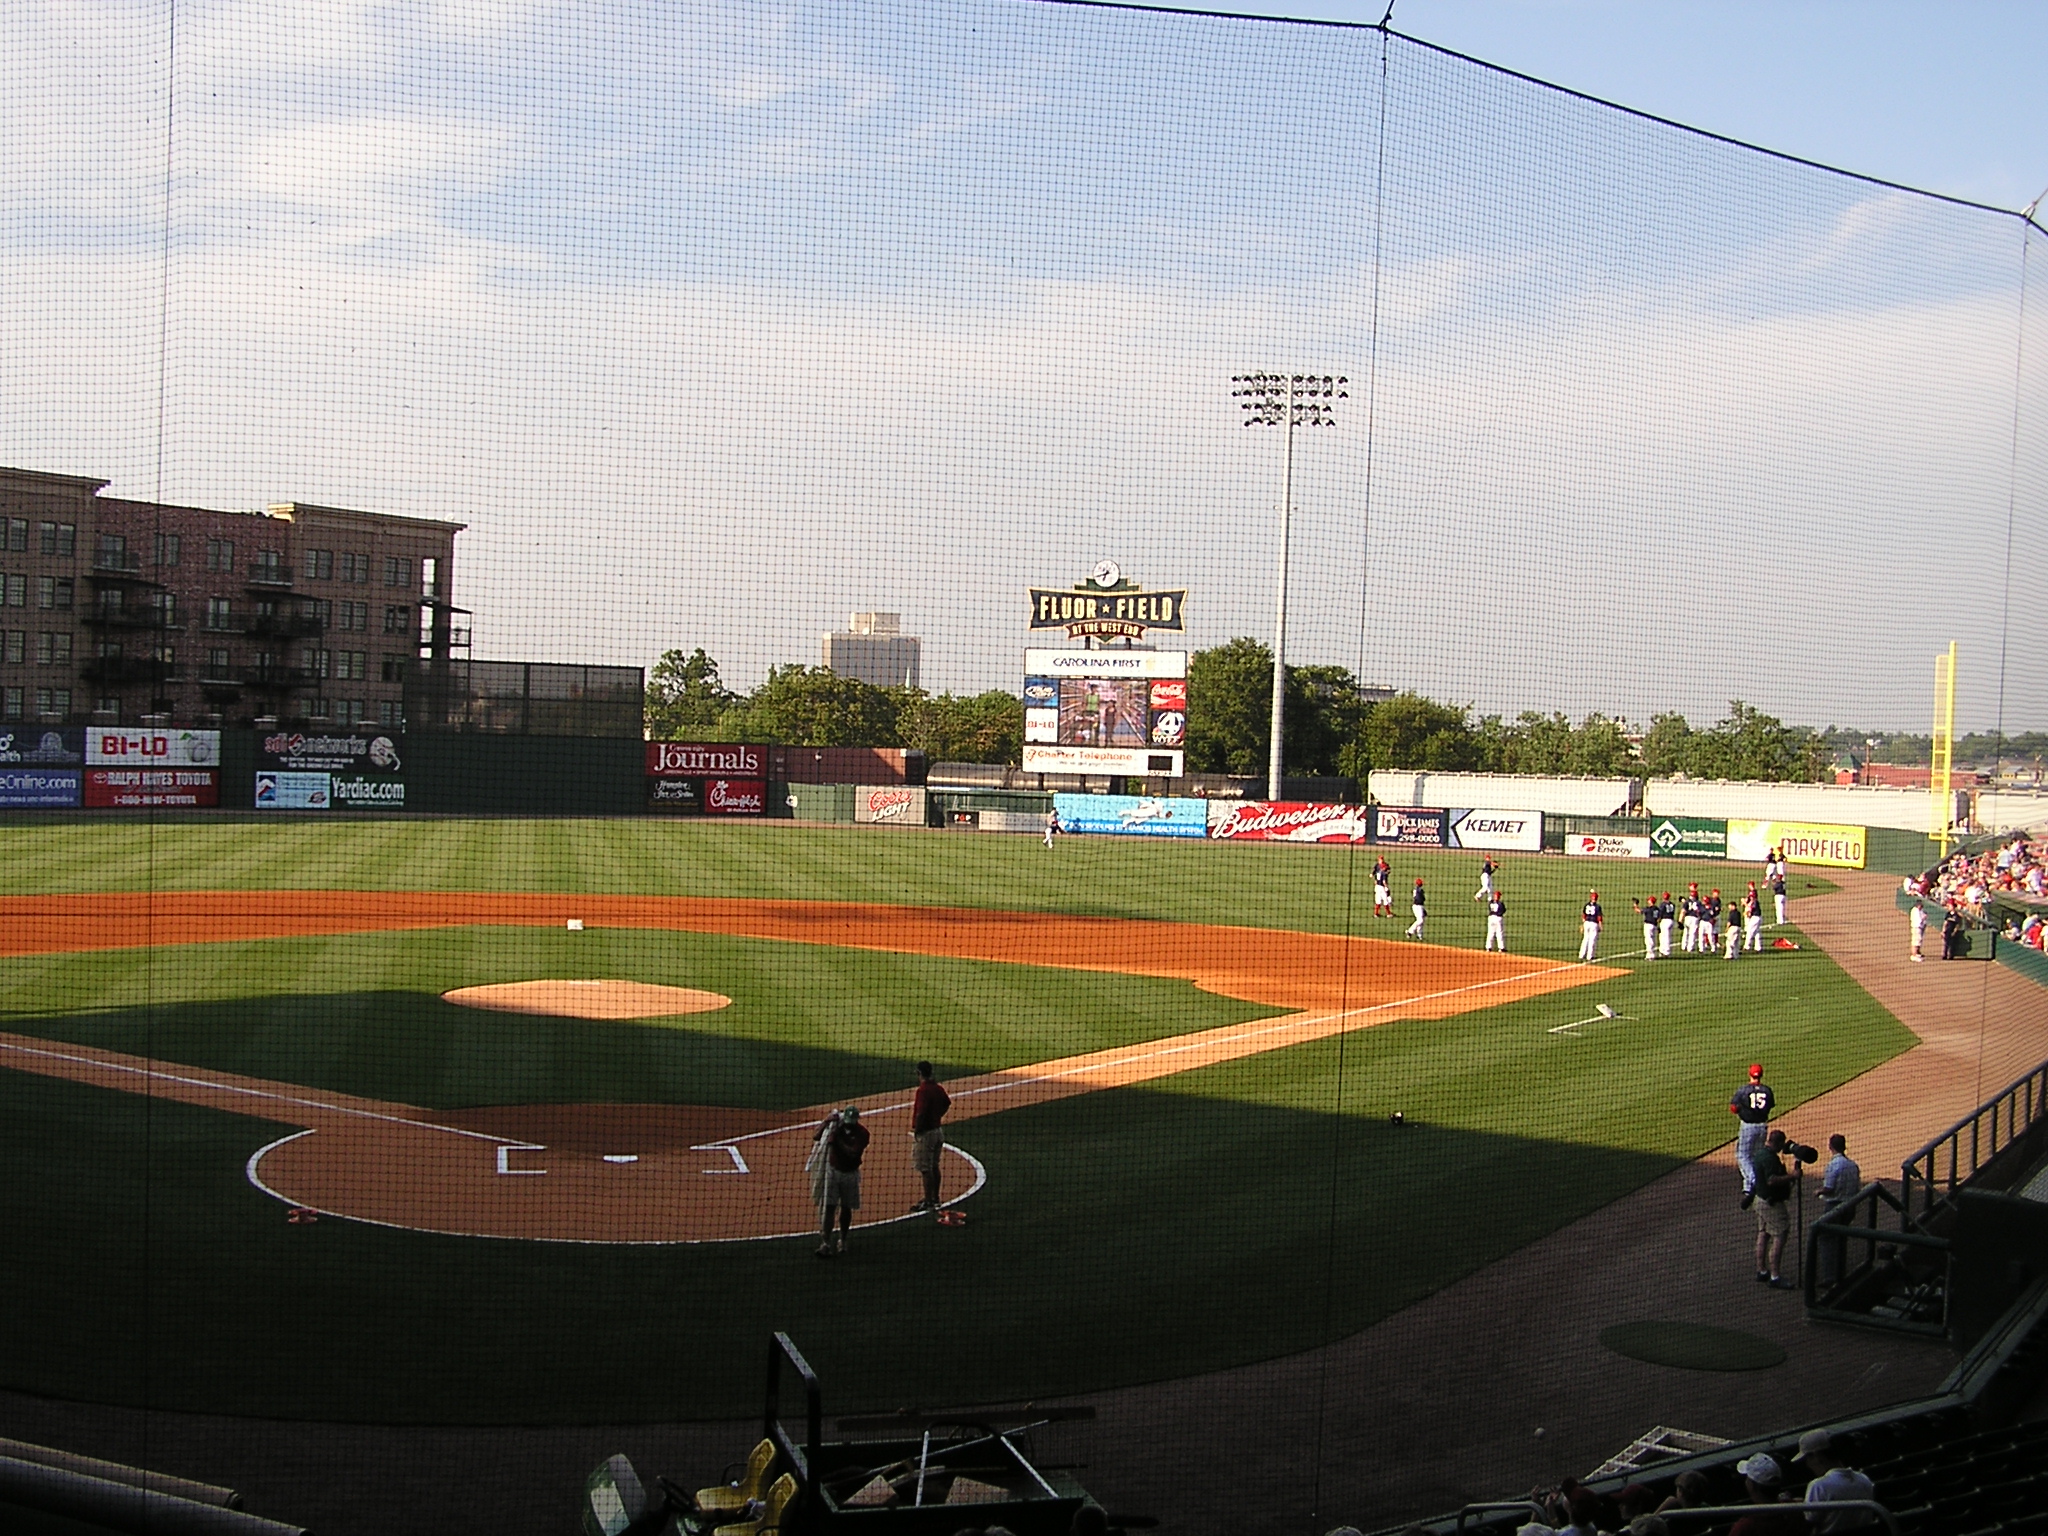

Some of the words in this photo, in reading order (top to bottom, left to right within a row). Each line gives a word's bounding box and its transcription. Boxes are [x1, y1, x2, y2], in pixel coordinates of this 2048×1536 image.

[1040, 595, 1097, 620] FLUOR
[1116, 597, 1173, 621] FIELD
[1084, 622, 1099, 633] THE
[1101, 622, 1122, 633] WEST
[1053, 657, 1110, 667] CAROLINA
[1113, 659, 1141, 667] FIRST
[102, 736, 168, 756] BI-LO
[654, 744, 759, 772] Journals
[1037, 750, 1075, 760] Charter
[1079, 750, 1133, 761] Telephone
[108, 772, 141, 786] RALPH
[175, 773, 212, 786] TOYOTA
[331, 777, 405, 799] Yardiac.com
[868, 790, 913, 812] Coors
[872, 801, 910, 823] LIGHT
[1211, 802, 1346, 839] Budweiser
[1398, 817, 1417, 827] DICK
[1417, 818, 1440, 829] JAMES
[1465, 819, 1528, 833] KEMET
[1399, 834, 1440, 843] 298-0000
[1598, 837, 1625, 846] Duke
[1597, 845, 1633, 855] Energy
[1780, 837, 1861, 861] MAYFIELD
[1749, 1092, 1767, 1109] 15
